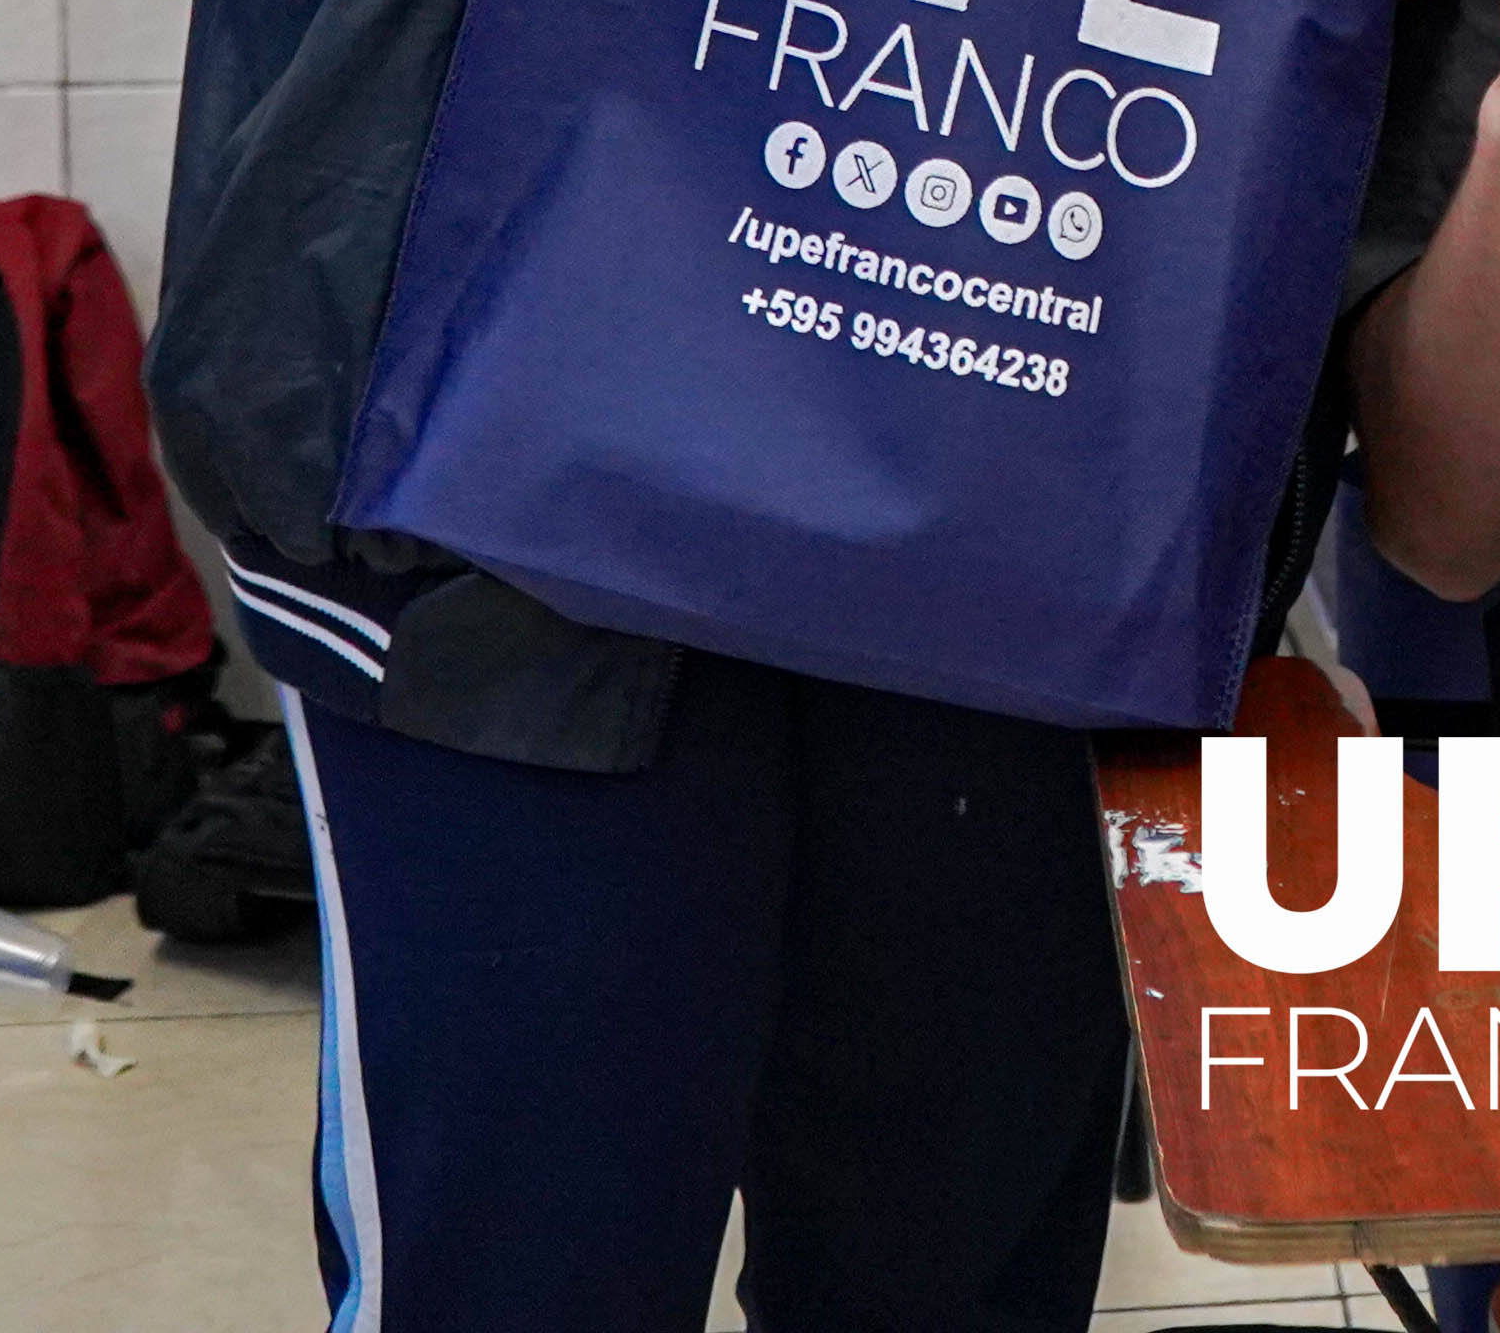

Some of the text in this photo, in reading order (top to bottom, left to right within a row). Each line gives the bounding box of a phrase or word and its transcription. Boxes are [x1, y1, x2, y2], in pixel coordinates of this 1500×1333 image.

[727, 206, 1103, 334] /upefrancocentral
[741, 286, 1070, 398] +595 994364238
